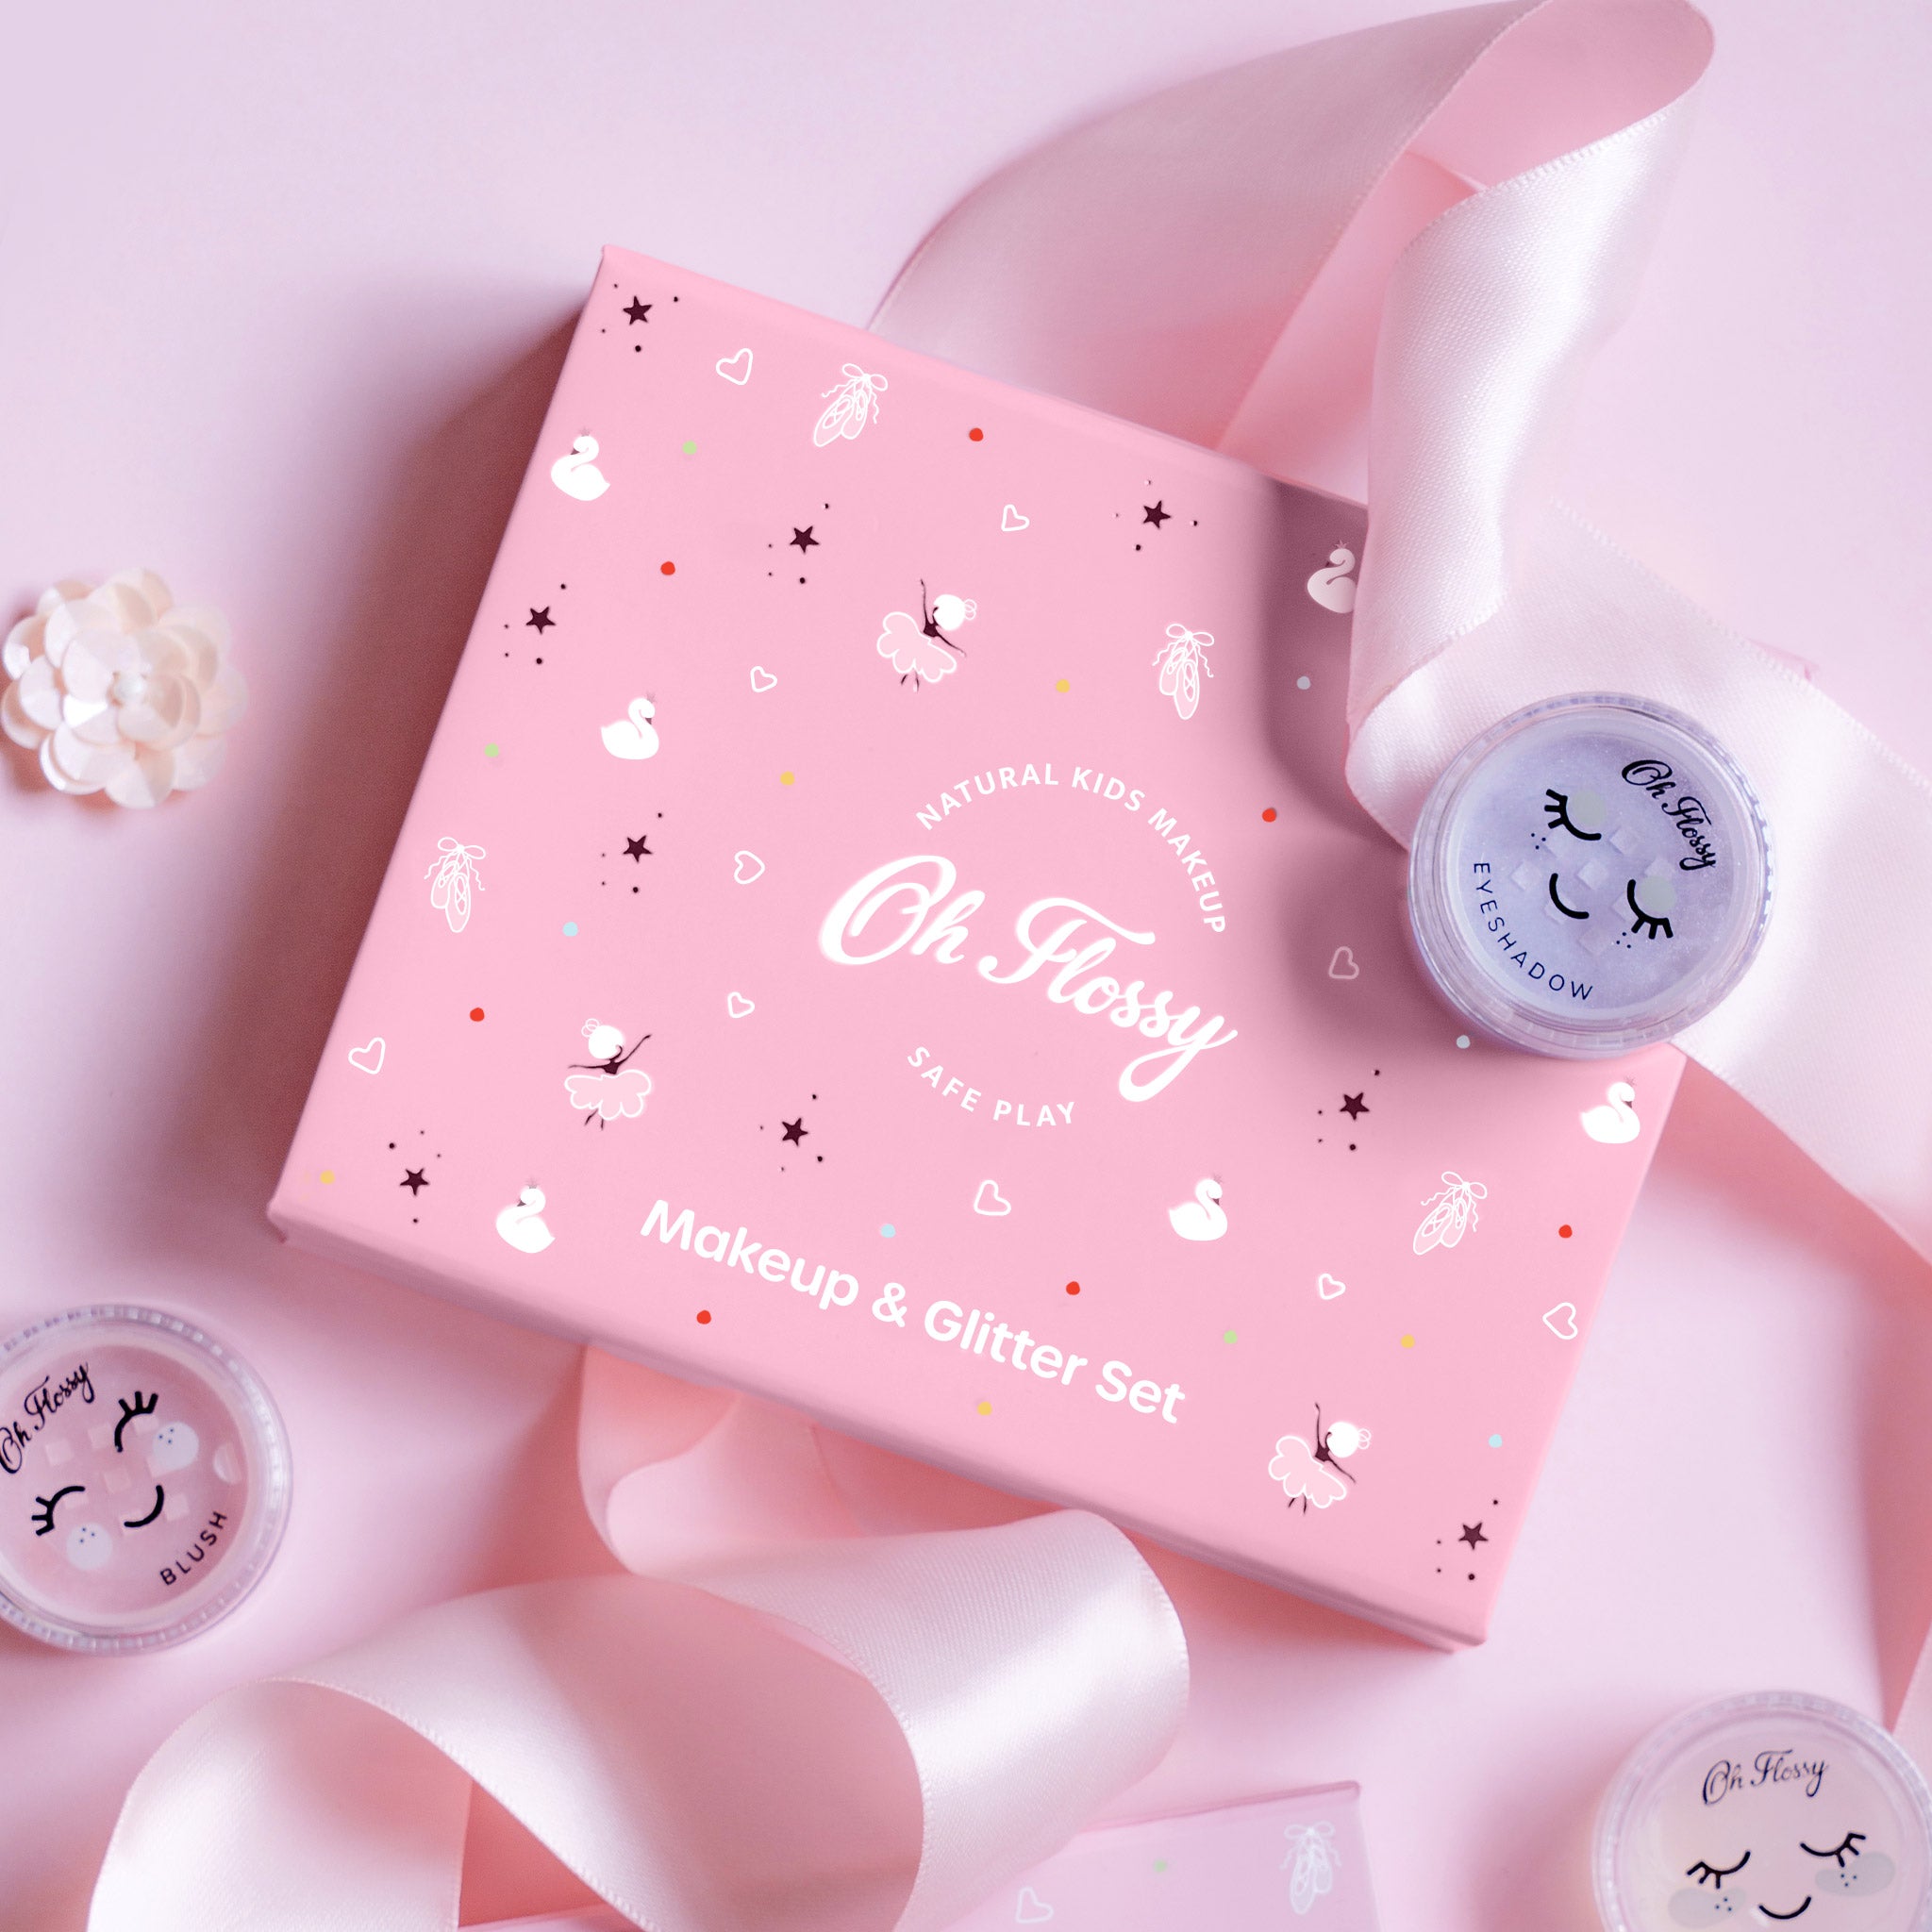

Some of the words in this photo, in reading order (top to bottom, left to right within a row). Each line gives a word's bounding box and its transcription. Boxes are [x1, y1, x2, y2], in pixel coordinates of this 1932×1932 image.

[916, 763, 1058, 830] NATURAL
[1072, 767, 1145, 811] KIDS
[1147, 808, 1225, 933] MAKEUP
[1622, 759, 1675, 799] Oh
[1661, 796, 1716, 871] Flossy
[820, 855, 985, 965] Oh
[978, 897, 1239, 1102] Flossy
[1474, 862, 1593, 1000] EYESHADOW
[908, 1046, 982, 1112] SAFE
[993, 1100, 1075, 1127] PLAY
[641, 1199, 859, 1310] Makeup
[872, 1283, 908, 1327] &
[924, 1300, 1088, 1385] Glitter
[1095, 1361, 1186, 1424] Set
[0, 1421, 31, 1474] Oh
[24, 1362, 95, 1431] Flossy
[159, 1511, 227, 1586] BLUSH
[1702, 1760, 1742, 1805] Oh
[1750, 1749, 1828, 1797] Flossy
